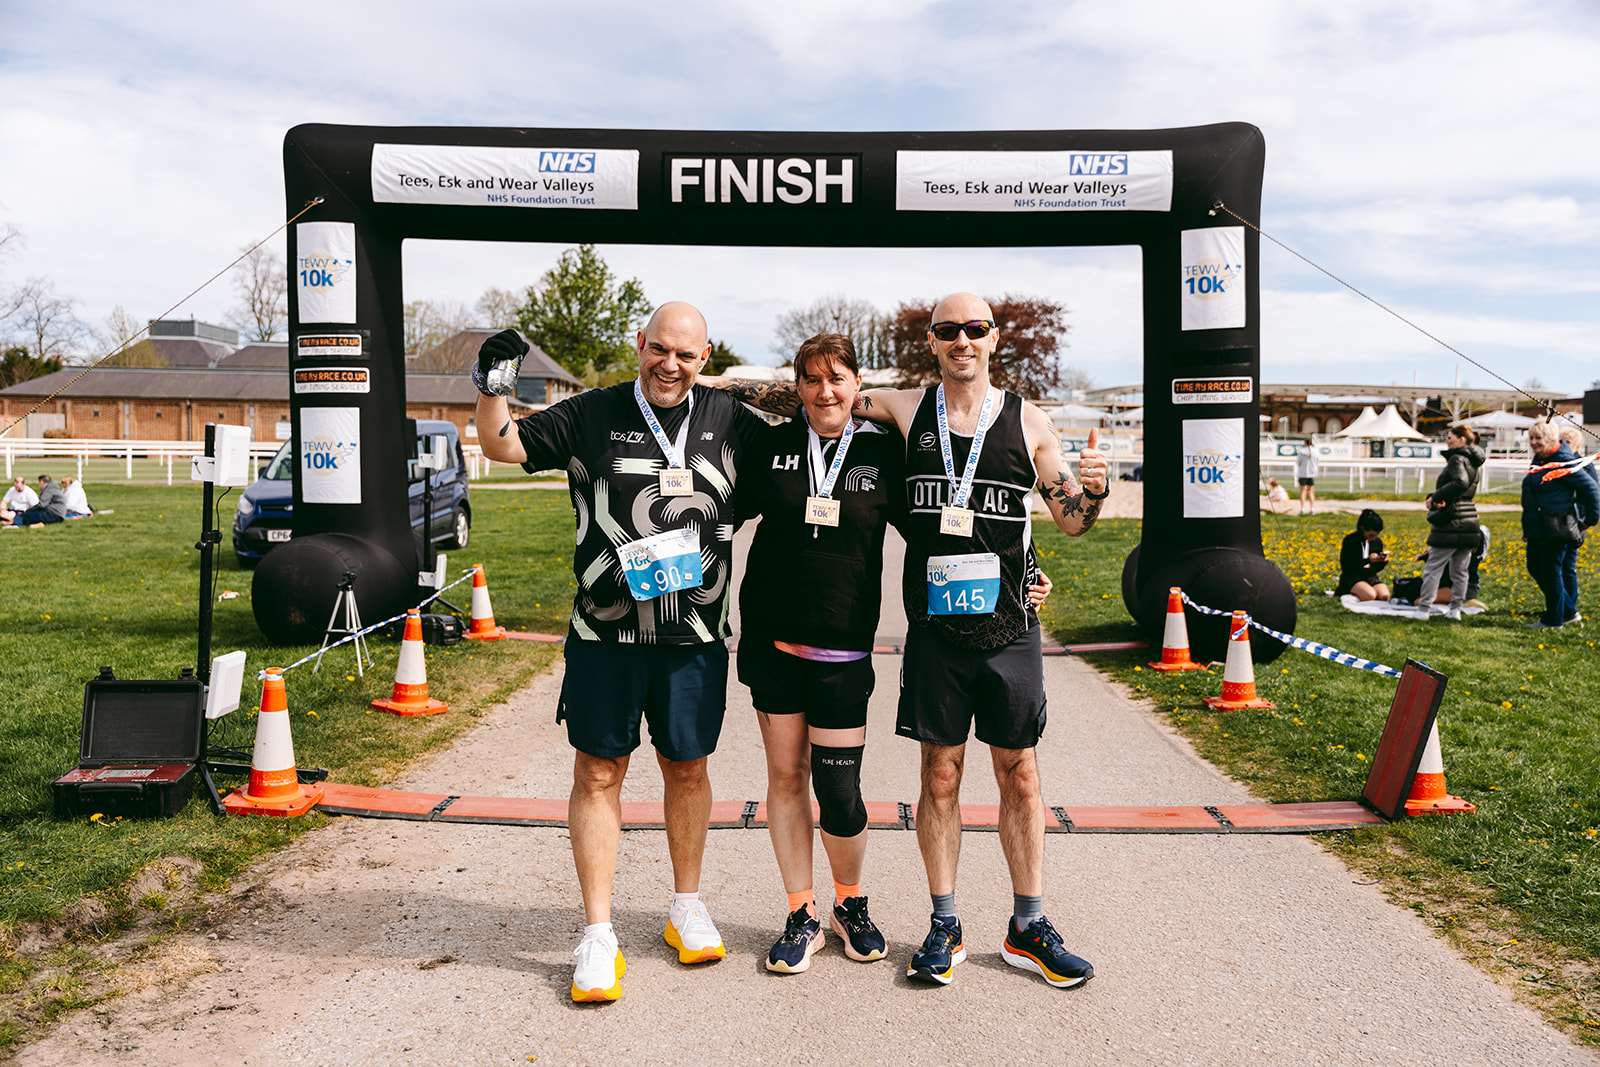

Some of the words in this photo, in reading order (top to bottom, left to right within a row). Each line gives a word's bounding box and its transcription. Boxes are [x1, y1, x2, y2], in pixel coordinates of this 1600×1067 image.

[540, 152, 594, 172] NHS
[1071, 155, 1126, 175] NHS
[398, 174, 433, 189] Tees,
[438, 175, 462, 188] Esk
[467, 176, 494, 190] and
[499, 178, 538, 191] Wear
[543, 179, 594, 194] Valleys
[671, 158, 853, 204] FINISH
[923, 181, 959, 195] Tees,
[965, 182, 989, 194] Esk
[994, 181, 1022, 194] and
[1028, 182, 1069, 194] Wear
[1074, 181, 1127, 197] Valleys
[487, 194, 508, 203] NHS
[511, 195, 568, 205] Foundation
[571, 196, 595, 205] Trust
[1014, 199, 1036, 208] NHS
[1039, 199, 1097, 208] Foundation
[1100, 199, 1126, 207] Trust
[299, 258, 329, 268] TEWV
[1184, 264, 1220, 276] TEWV
[300, 269, 334, 287] 10k
[1185, 276, 1225, 294] 10k
[640, 401, 654, 420] TEWV
[650, 421, 661, 434] 10k
[610, 431, 626, 441] tcs
[303, 441, 333, 451] TEWV
[304, 452, 339, 469] 10k
[772, 455, 800, 470] LH
[832, 458, 842, 470] 10k
[968, 452, 978, 465] 10k
[1185, 455, 1220, 465] TEWV
[1186, 466, 1224, 483] 10k
[666, 480, 682, 488] 10k
[982, 487, 1009, 513] AC
[812, 510, 828, 518] 10k
[946, 519, 961, 528] 10k
[271, 531, 292, 540] CP6
[624, 547, 645, 560] TEWV
[654, 566, 681, 592] 90
[928, 571, 948, 582] 10k
[942, 588, 986, 612] 145
